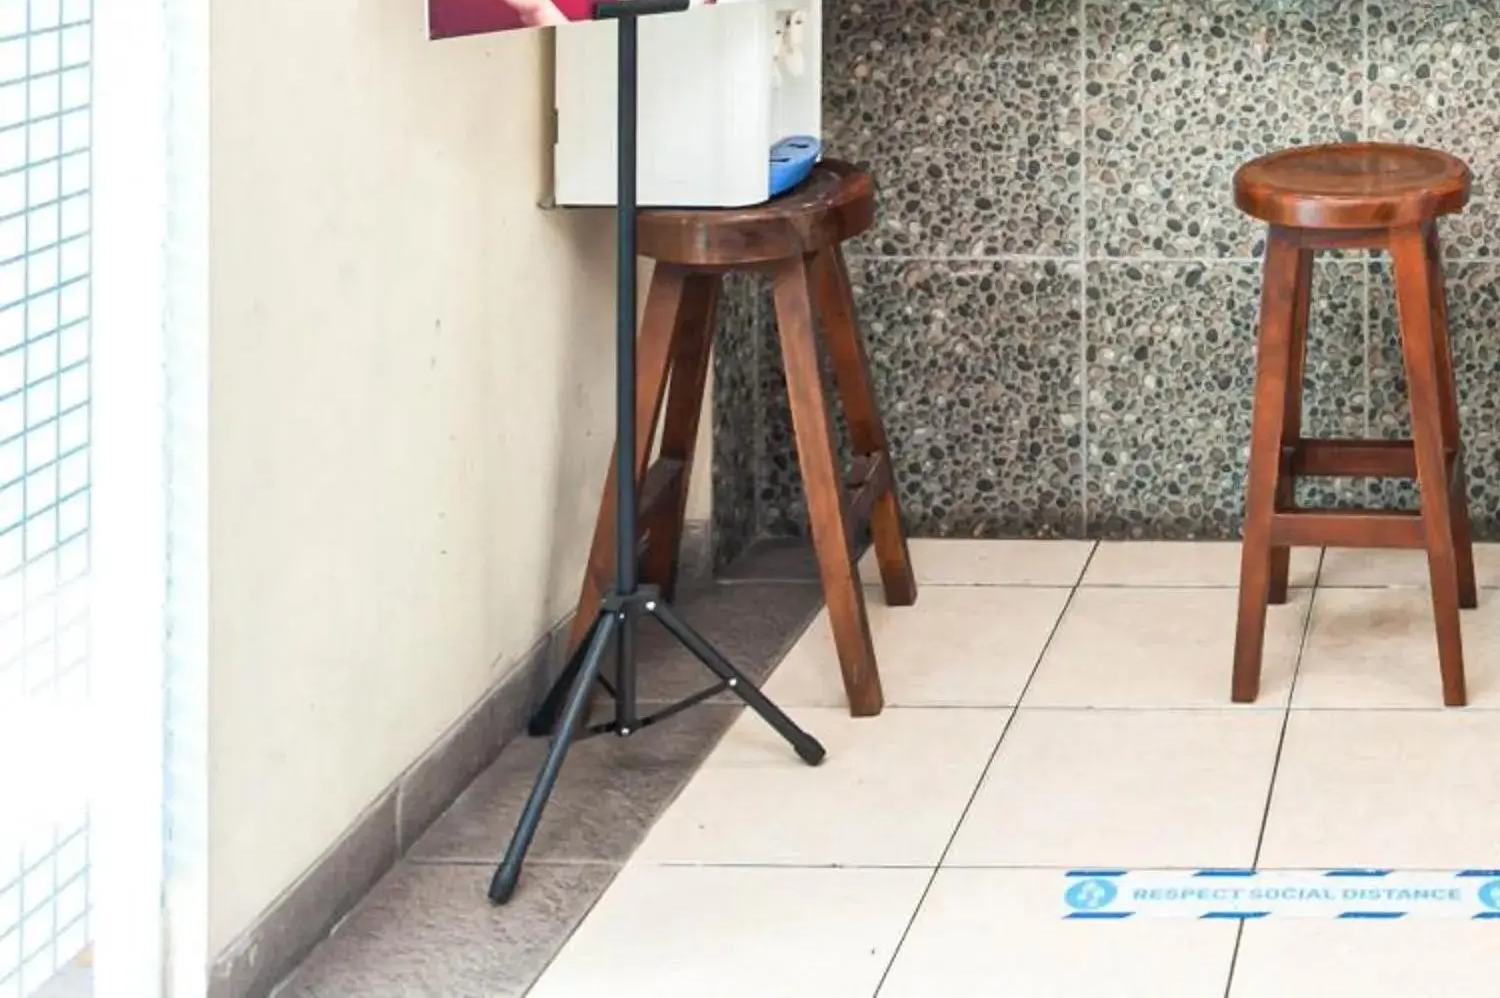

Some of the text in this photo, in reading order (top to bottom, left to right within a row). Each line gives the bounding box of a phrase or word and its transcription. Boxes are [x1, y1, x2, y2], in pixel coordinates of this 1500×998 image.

[1133, 887, 1461, 901] RESPECT SOCIAL DISTANCE
